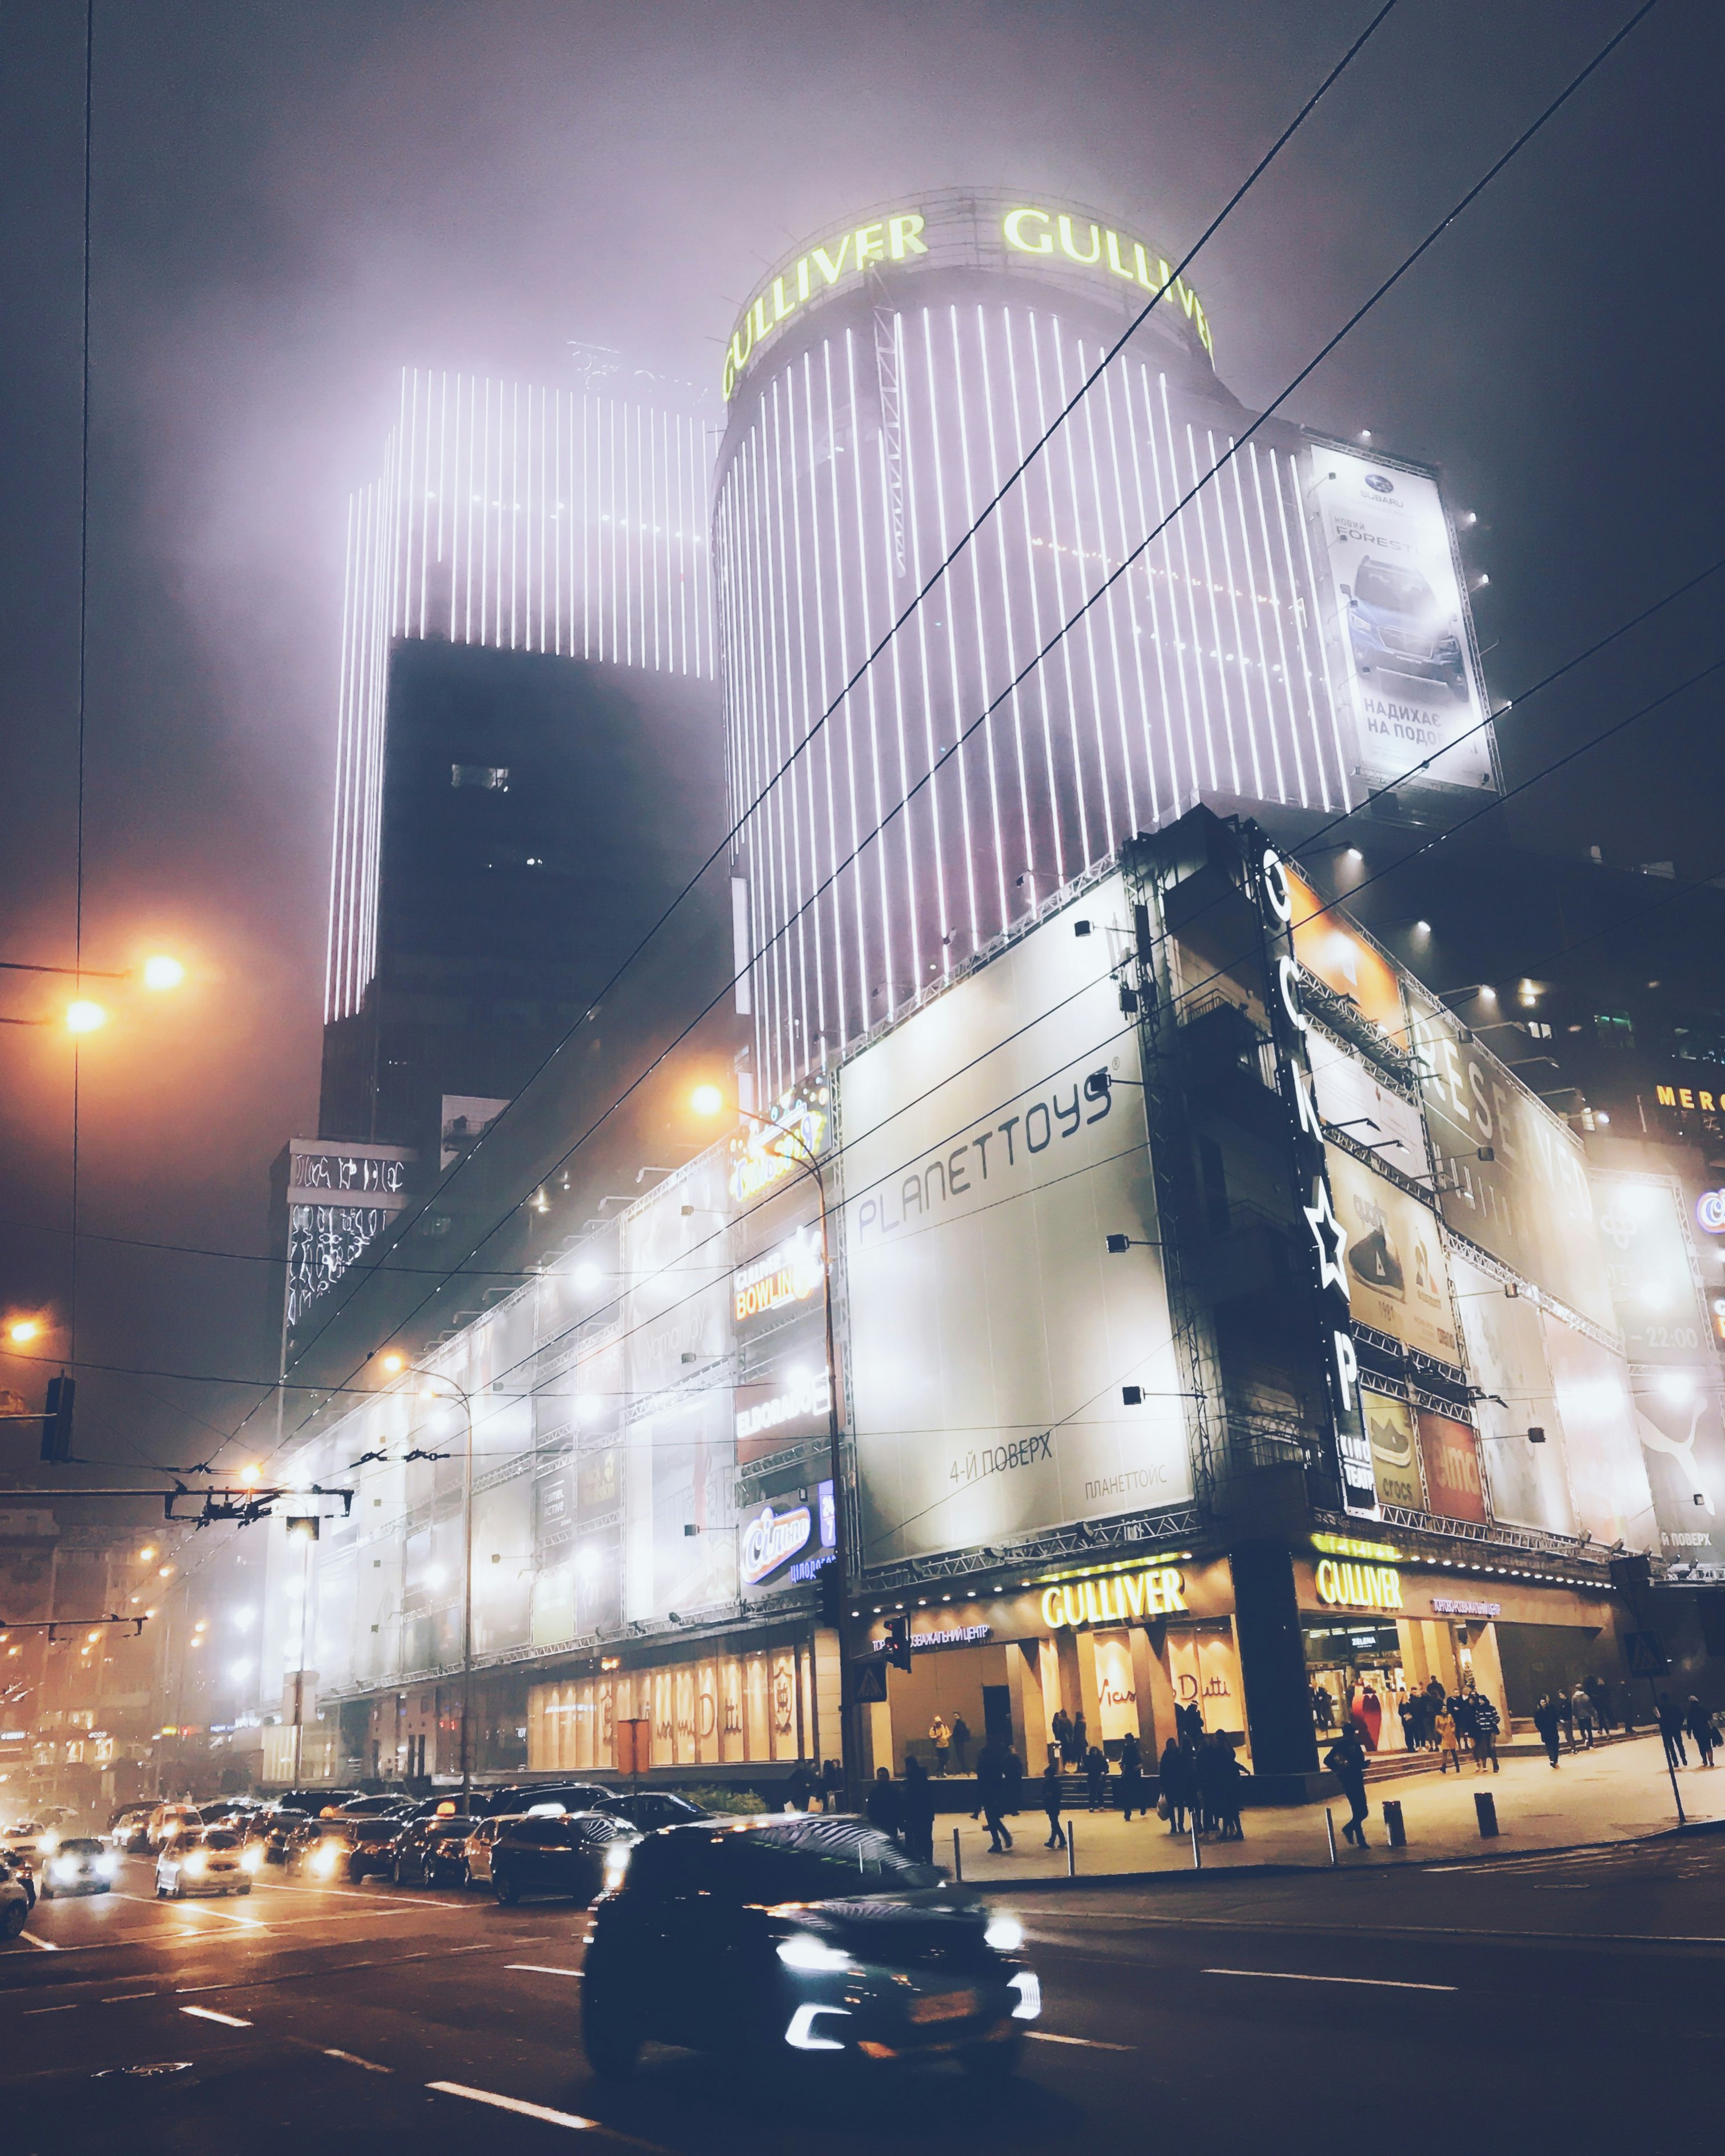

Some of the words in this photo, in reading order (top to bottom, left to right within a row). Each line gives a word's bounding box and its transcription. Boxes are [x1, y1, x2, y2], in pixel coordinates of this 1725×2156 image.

[722, 213, 928, 402] GULLIVER
[1360, 490, 1404, 508] SUBARU
[1335, 516, 1365, 532] НОВИЙ
[1364, 697, 1442, 728] НАДИХАЄ
[1367, 717, 1391, 737] НА
[1410, 1006, 1593, 1223] RESEVED
[858, 1065, 1113, 1244] PLANETTOYS
[736, 1266, 798, 1321] BOWLIN
[1646, 1326, 1699, 1350] 22:00
[951, 1450, 977, 1484] 4-Й
[983, 1432, 1053, 1474] ПОВЕРХ
[1085, 1465, 1168, 1500] ПЛАНЕТТОЙС
[1383, 1478, 1413, 1502] crocs
[745, 1517, 809, 1574] Сільпо
[1671, 1533, 1712, 1546] ПОВЕРХ
[1041, 1567, 1189, 1630] GULLIVER
[1317, 1559, 1404, 1608] GULLIVER
[963, 1624, 989, 1643] ЦЕНТР
